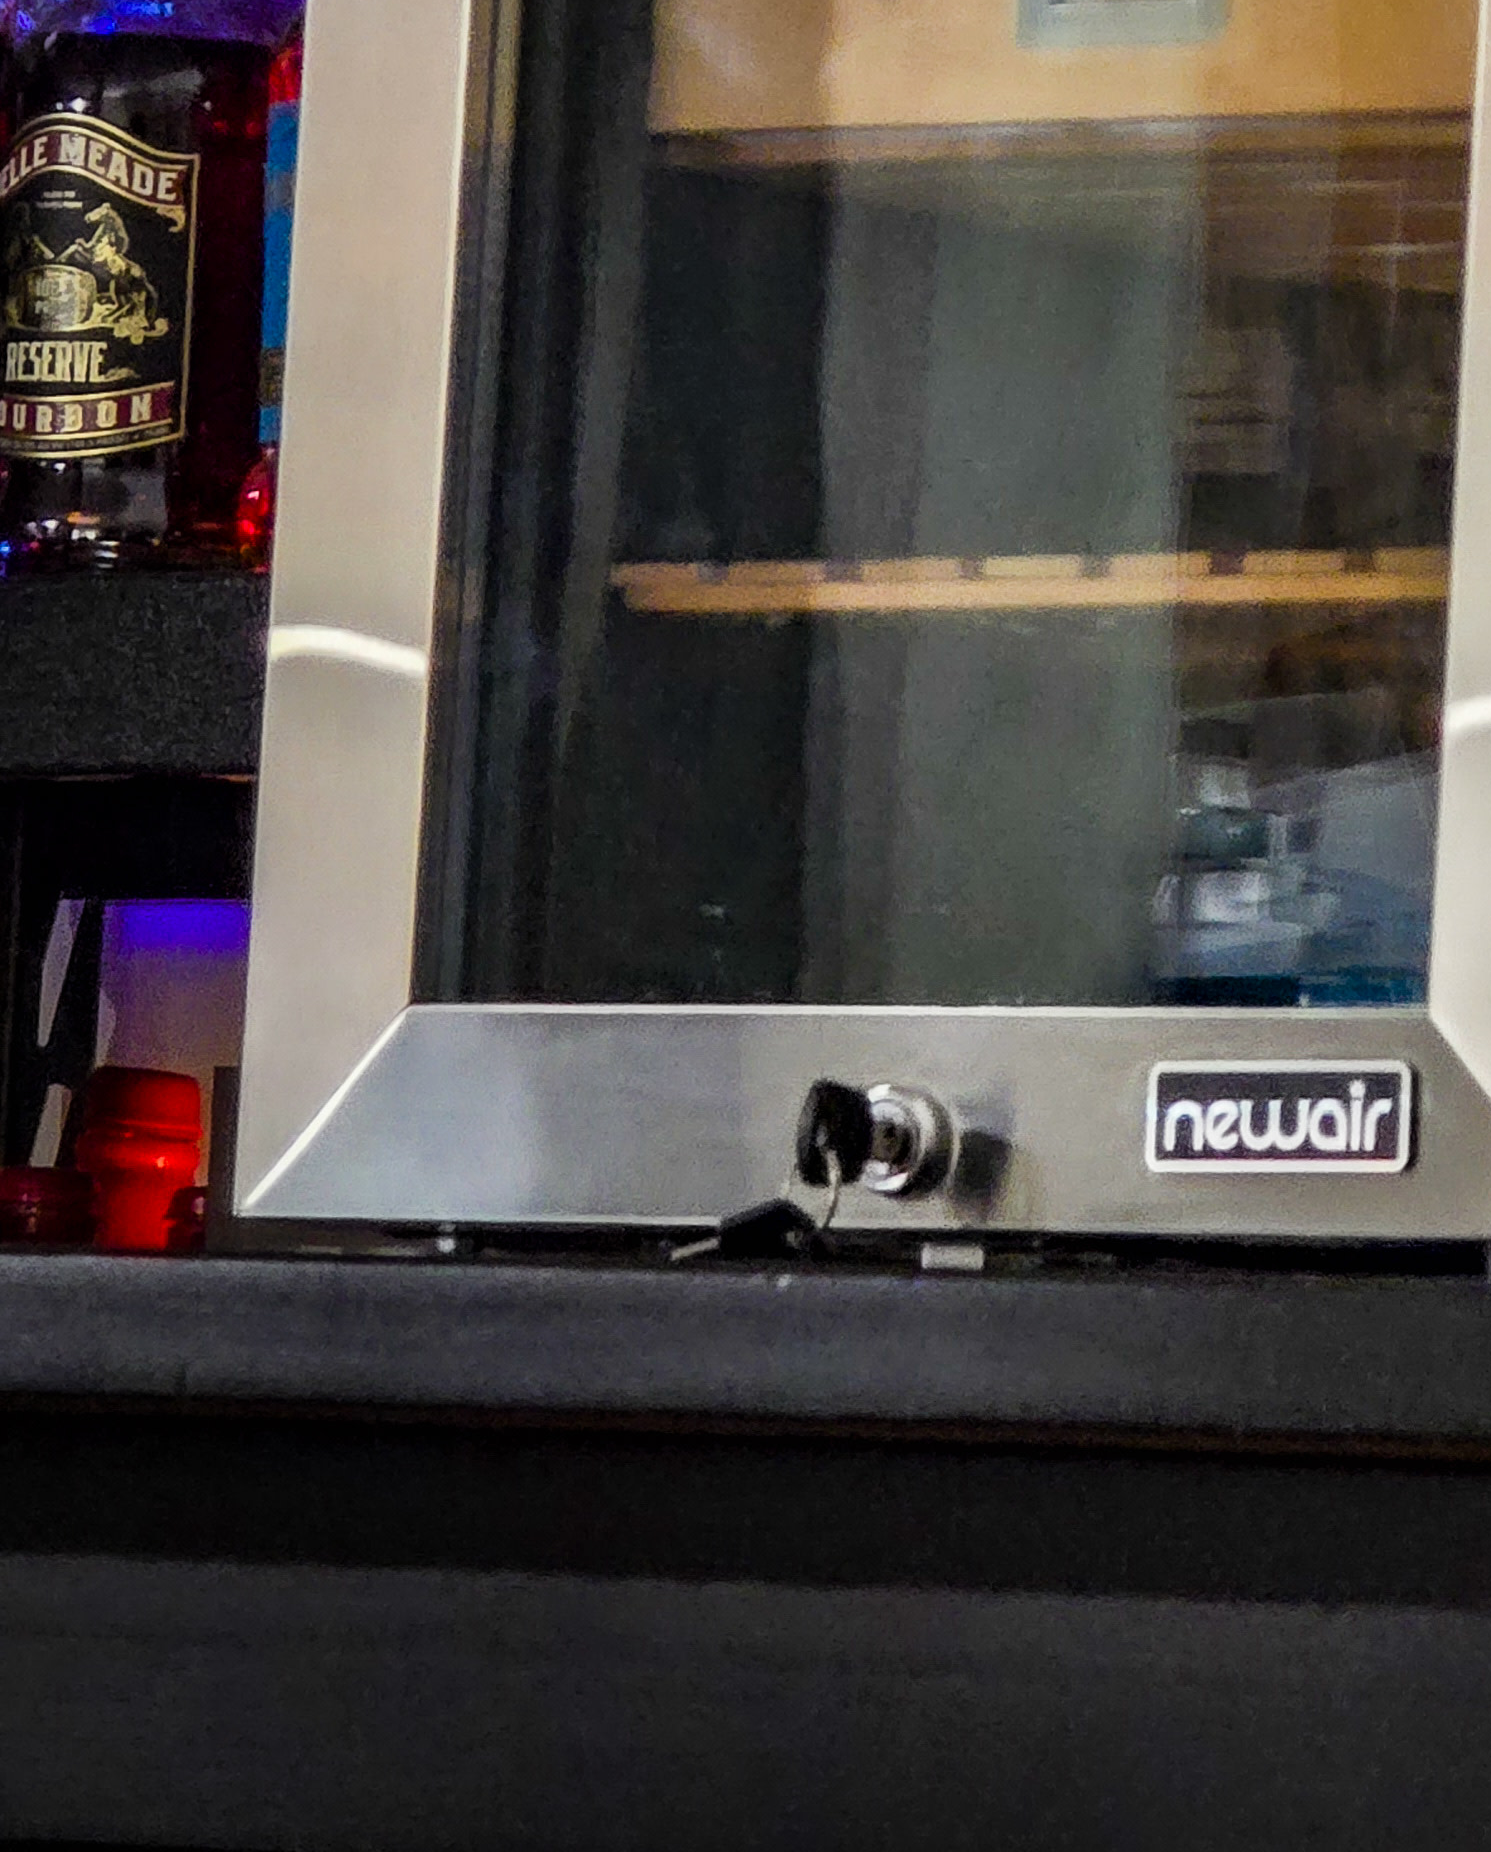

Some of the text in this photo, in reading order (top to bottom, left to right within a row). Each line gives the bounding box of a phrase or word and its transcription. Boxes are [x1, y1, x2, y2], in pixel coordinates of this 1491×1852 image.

[58, 133, 180, 202] MEADE
[5, 340, 108, 383] RESERVE
[1163, 1078, 1393, 1152] newair
